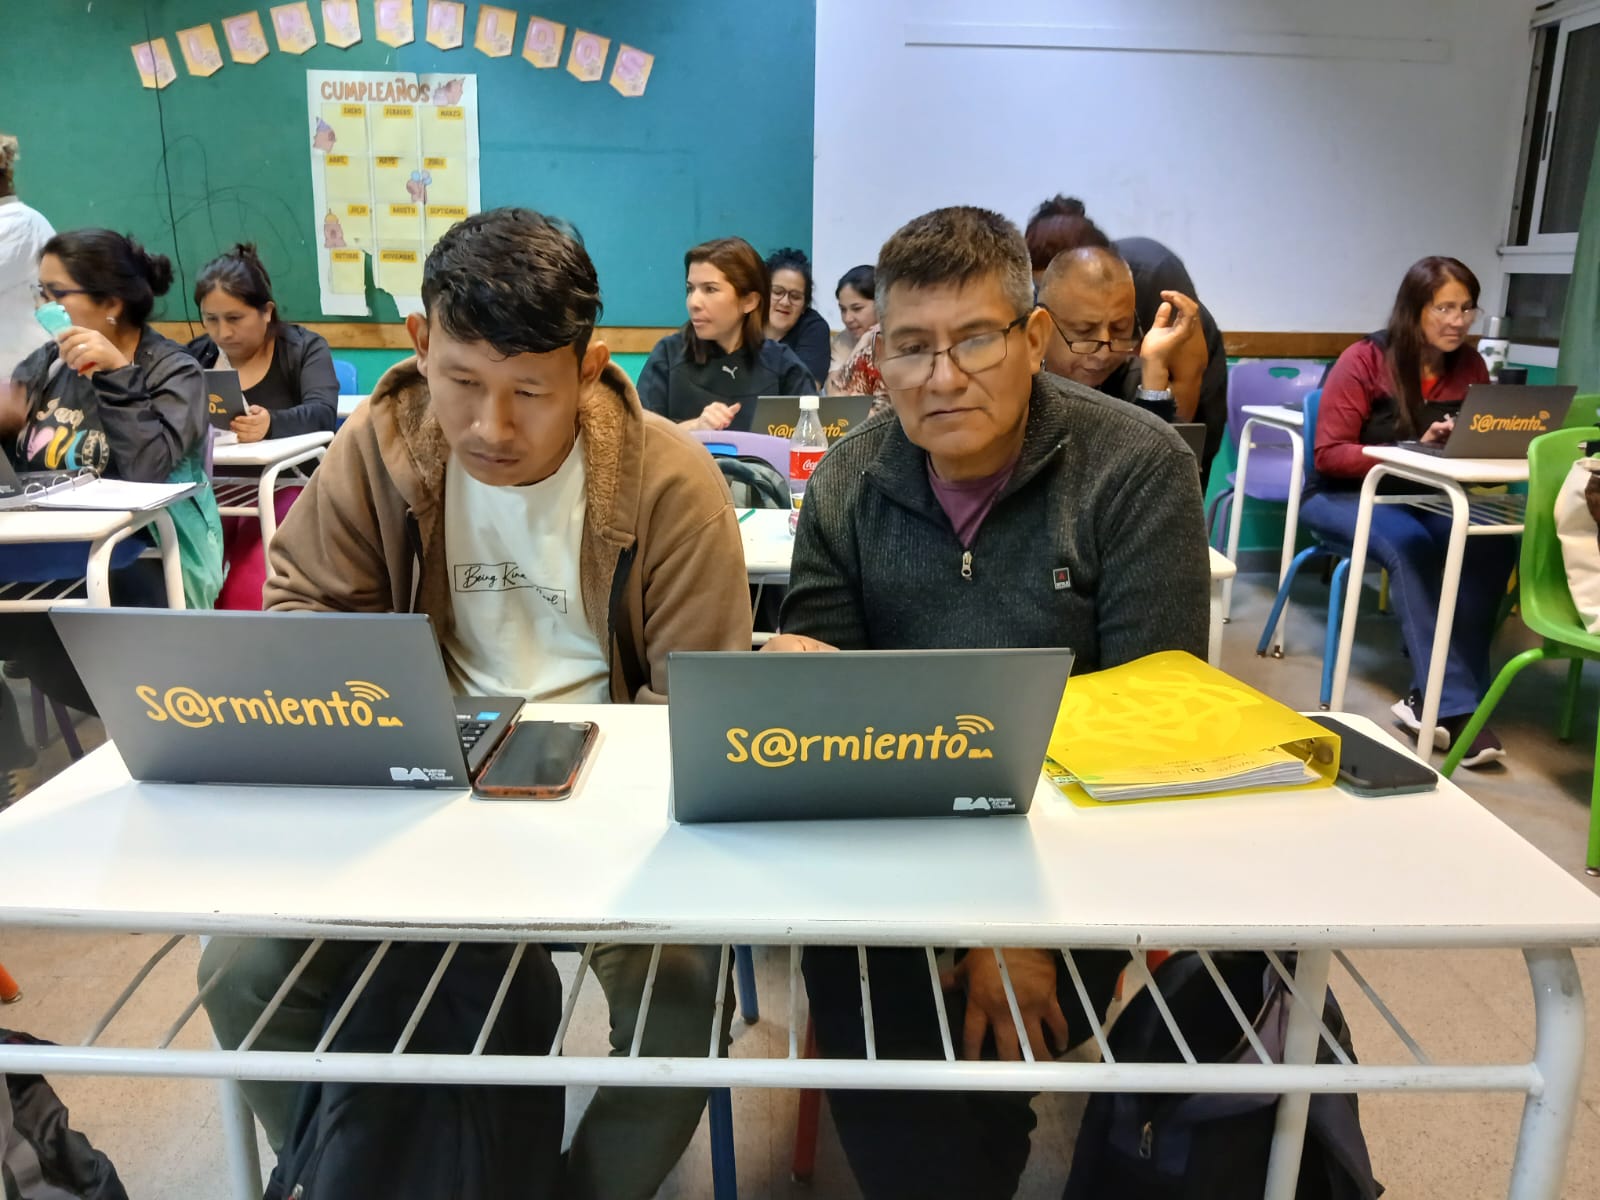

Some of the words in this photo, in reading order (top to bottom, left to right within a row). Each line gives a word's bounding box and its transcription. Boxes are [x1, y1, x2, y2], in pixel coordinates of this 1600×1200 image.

[320, 78, 432, 103] CUMPLEAÑOS
[463, 566, 498, 588] Being
[136, 684, 373, 728] S@rmiento
[726, 725, 969, 767] S@rmiento
